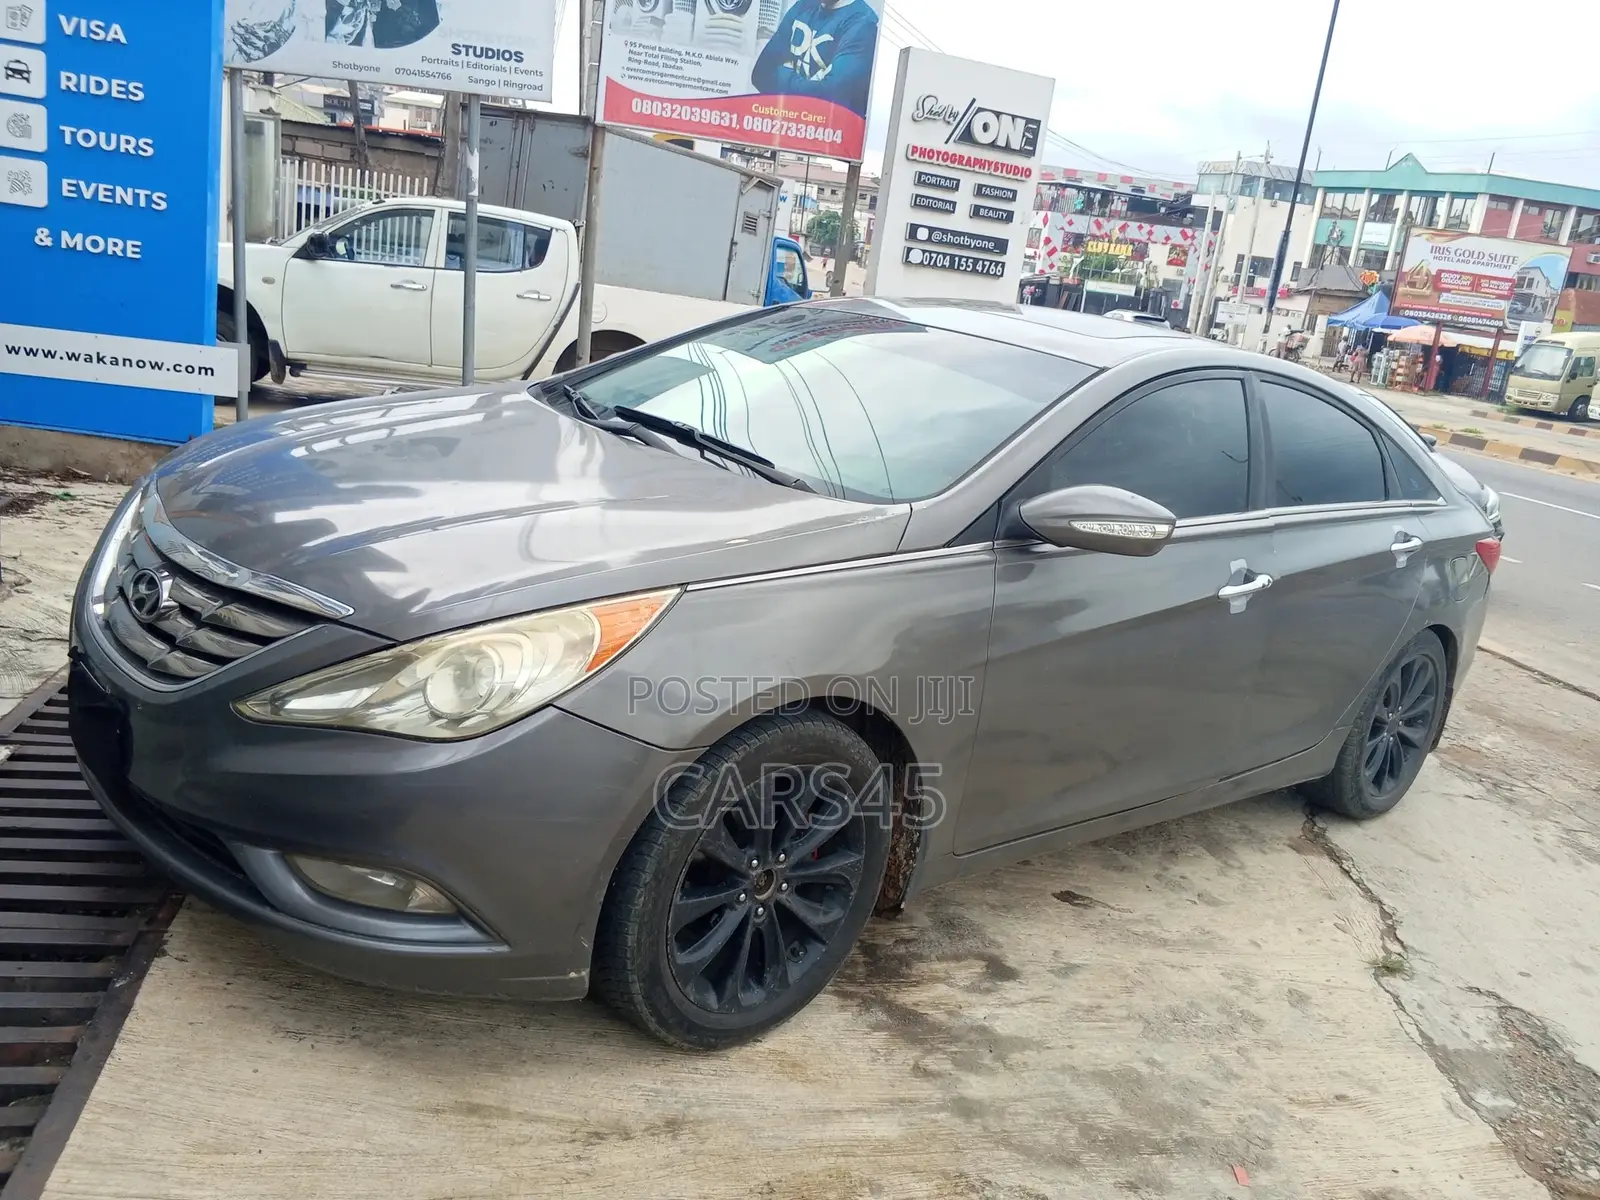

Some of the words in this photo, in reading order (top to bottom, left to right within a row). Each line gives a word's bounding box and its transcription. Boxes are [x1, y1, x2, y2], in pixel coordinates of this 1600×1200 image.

[58, 14, 127, 45] VISA
[451, 43, 525, 63] STUDIOS
[628, 49, 643, 57] Near
[644, 52, 659, 60] Total
[332, 61, 381, 73] Shotbyone
[395, 67, 452, 81] 07041554766
[468, 75, 496, 87] Sango
[503, 80, 543, 91] Ringroad
[421, 55, 460, 67] Portraits
[466, 61, 508, 73] Editorials
[514, 67, 544, 77] Events
[59, 71, 145, 102] RIDES
[631, 98, 740, 130] 08032039631,
[743, 116, 843, 144] 08027338404
[752, 103, 799, 120] Customer
[801, 110, 826, 124] Care:
[59, 125, 154, 157] TOURS
[970, 110, 1038, 151] ONE
[920, 175, 958, 189] PORTRAIT
[981, 186, 1014, 199] FASHION
[61, 178, 168, 211] EVENTS
[916, 197, 954, 211] EDITORIAL
[979, 208, 1008, 220] BEAUTY
[34, 227, 53, 248] &
[60, 231, 142, 259] MORE
[923, 254, 950, 269] 0704
[954, 257, 973, 272] 155
[976, 260, 1003, 276] 4766
[1430, 245, 1452, 256] IRIS
[1454, 248, 1485, 260] GOLD
[1488, 252, 1519, 265] SUITE
[1433, 255, 1454, 263] HOTEL
[1472, 260, 1512, 270] APARTMENT
[5, 342, 215, 378] www.wakanow.com
